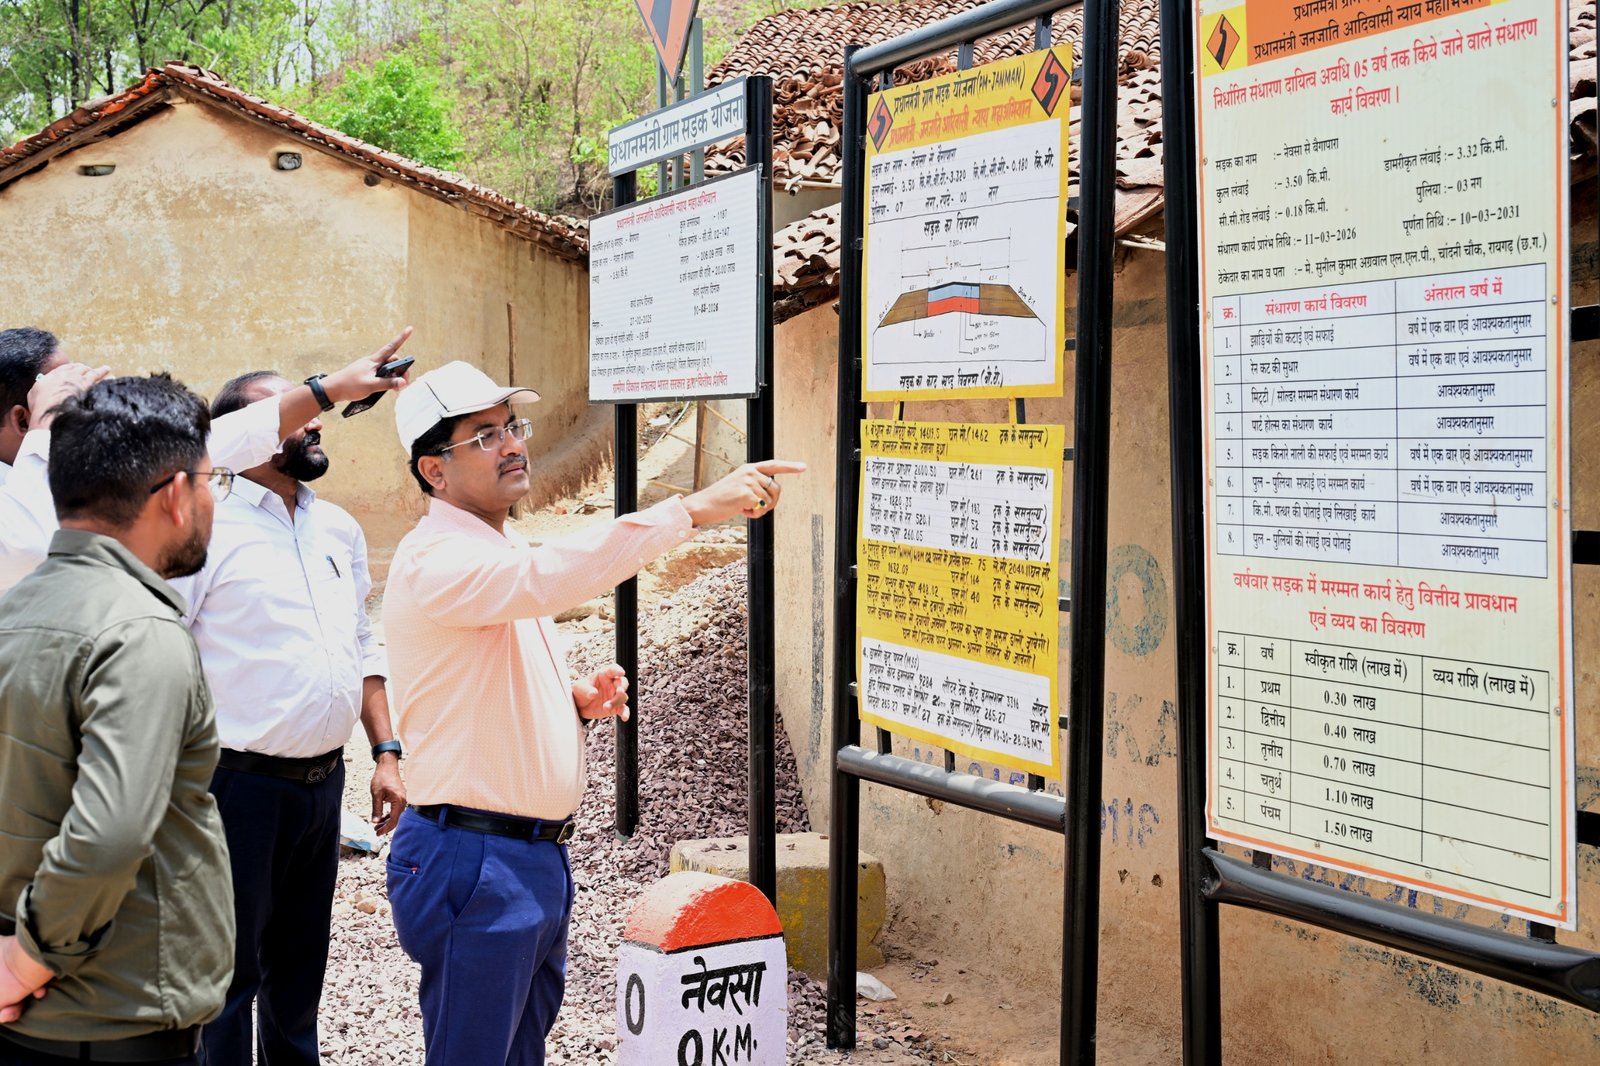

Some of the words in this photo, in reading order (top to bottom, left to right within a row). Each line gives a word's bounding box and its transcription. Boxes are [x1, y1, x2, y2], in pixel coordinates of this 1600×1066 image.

[1254, 31, 1296, 59] प्रधानमंत्री
[1299, 19, 1339, 47] जनजाति
[1344, 5, 1393, 36] आदिवासी
[1397, 3, 1421, 20] न्याय
[1213, 83, 1246, 109] निर्धारित
[1250, 78, 1282, 101] संधारण
[1285, 67, 1316, 93] दायित्व
[1320, 58, 1350, 85] अवधि
[1354, 60, 1368, 78] 05
[1371, 46, 1387, 72] वर्ष
[1391, 49, 1409, 69] तक
[1413, 36, 1437, 64] किये
[1441, 29, 1463, 56] जाने
[1467, 22, 1492, 50] वाले
[1495, 18, 1538, 45] संधारण
[894, 85, 920, 116] प्रधानमंत्री
[936, 84, 950, 108] सड़क
[1330, 89, 1352, 115] कार्य
[1356, 86, 1391, 110] विवरण
[610, 119, 662, 166] प्रधानमंत्री
[662, 120, 680, 148] ग्राम
[681, 109, 708, 143] सड़क
[711, 93, 743, 128] योजना
[1216, 158, 1232, 172] सड़क
[1234, 156, 1244, 166] का
[1245, 153, 1257, 164] नाम
[1283, 143, 1302, 158] नेवसा
[1304, 139, 1311, 154] से
[1384, 153, 1417, 172] डामरीकृत
[1420, 146, 1441, 165] लंबाई
[1457, 144, 1477, 160] 3.32
[1480, 135, 1507, 154] कि.मी.
[1216, 187, 1229, 203] कुल
[1231, 180, 1249, 197] लंबाई
[1285, 175, 1302, 188] 3.50
[1307, 167, 1330, 184] कि.मी.
[1416, 181, 1441, 203] पुलिया
[1457, 179, 1468, 192] 03
[1471, 177, 1482, 189] नग
[924, 221, 940, 240] सड़क
[944, 218, 952, 234] का
[957, 214, 979, 236] विवरण
[1252, 205, 1270, 223] लंबाई
[1285, 205, 1303, 218] 0.18
[1305, 198, 1328, 214] कि.मी.
[1403, 214, 1423, 236] पूर्णता
[1426, 211, 1444, 230] तिथि
[1460, 205, 1520, 225] 10-03-2031
[1218, 241, 1239, 255] संधारण
[1242, 237, 1255, 251] कार्य
[1257, 235, 1273, 251] प्रारंभ
[1275, 232, 1291, 248] तिथि
[1305, 227, 1356, 245] 11-03-2026
[1218, 269, 1238, 284] ठेकेदार
[1241, 271, 1249, 281] का
[1252, 268, 1263, 280] नाम
[1266, 268, 1271, 278] व
[1273, 266, 1285, 277] पता
[1305, 259, 1313, 274] मे.
[1316, 258, 1336, 277] सुनील
[1338, 258, 1357, 275] कुमार
[1360, 255, 1387, 269] अग्रवाल
[1438, 242, 1461, 259] चांदनी
[1464, 239, 1485, 257] चौक,
[1488, 239, 1513, 254] रायगढ़
[1516, 232, 1547, 254] (छ.ग.)
[1223, 307, 1237, 319] क्र.
[1265, 299, 1300, 315] संधारण
[1304, 294, 1327, 312] कार्य
[1331, 293, 1367, 311] विवरण
[1424, 283, 1466, 302] अंतराल
[1469, 278, 1488, 296] वर्ष
[1492, 277, 1503, 295] में
[1274, 329, 1283, 344] की
[1315, 324, 1334, 343] सफाई
[1408, 317, 1419, 335] वर्ष
[1429, 321, 1442, 337] एक
[1444, 320, 1456, 333] बार
[1458, 314, 1469, 335] एवं
[1472, 314, 1532, 334] आवश्यकतानुसार
[900, 375, 914, 392] सड़क
[958, 368, 979, 389] विवरण
[1233, 568, 1268, 591] वर्षवार
[1272, 576, 1303, 596] सड़क
[1307, 572, 1317, 594] में
[1321, 580, 1359, 598] मरम्मत
[1363, 579, 1391, 601] कार्य
[1396, 579, 1415, 611] हेतु
[1418, 581, 1460, 607] वित्तीय
[1465, 592, 1517, 613] प्रावधान
[1309, 606, 1327, 631] एवं
[1331, 613, 1355, 630] व्यय
[1359, 616, 1377, 633] का
[1382, 612, 1425, 639] विवरण
[1228, 642, 1240, 656] क्र.
[1260, 643, 1274, 661] वर्ष
[1305, 649, 1335, 673] स्वीकृत
[1339, 652, 1358, 671] राशि
[1361, 656, 1390, 677] (लाख
[1394, 658, 1407, 683] में)
[1432, 669, 1454, 685] व्यय
[1458, 668, 1478, 689] राशि
[1483, 672, 1516, 695] (लाख
[1520, 675, 1535, 701] में)
[1227, 676, 1234, 689] 1.
[1260, 681, 1281, 695] प्रथम
[1324, 690, 1347, 706] 0.30
[1353, 694, 1376, 710] लाख
[1227, 706, 1234, 719] 2.
[1324, 723, 1347, 739] 0.40
[1353, 728, 1376, 743] लाख
[1227, 737, 1234, 749] 3.
[1324, 755, 1346, 771] 0.70
[1352, 760, 1376, 777] लाख
[1227, 768, 1234, 780] 4.
[1261, 773, 1282, 793] चतुर्थ
[1326, 788, 1347, 804] 1.10
[1350, 793, 1374, 810] लाख
[1227, 797, 1234, 810] 5.
[1260, 801, 1281, 820] पंचम
[1325, 820, 1346, 837] 1.50
[1350, 826, 1373, 842] लाख
[625, 973, 645, 1035] 0
[681, 956, 767, 1015] नेवसा
[712, 1023, 757, 1066] K.M.
